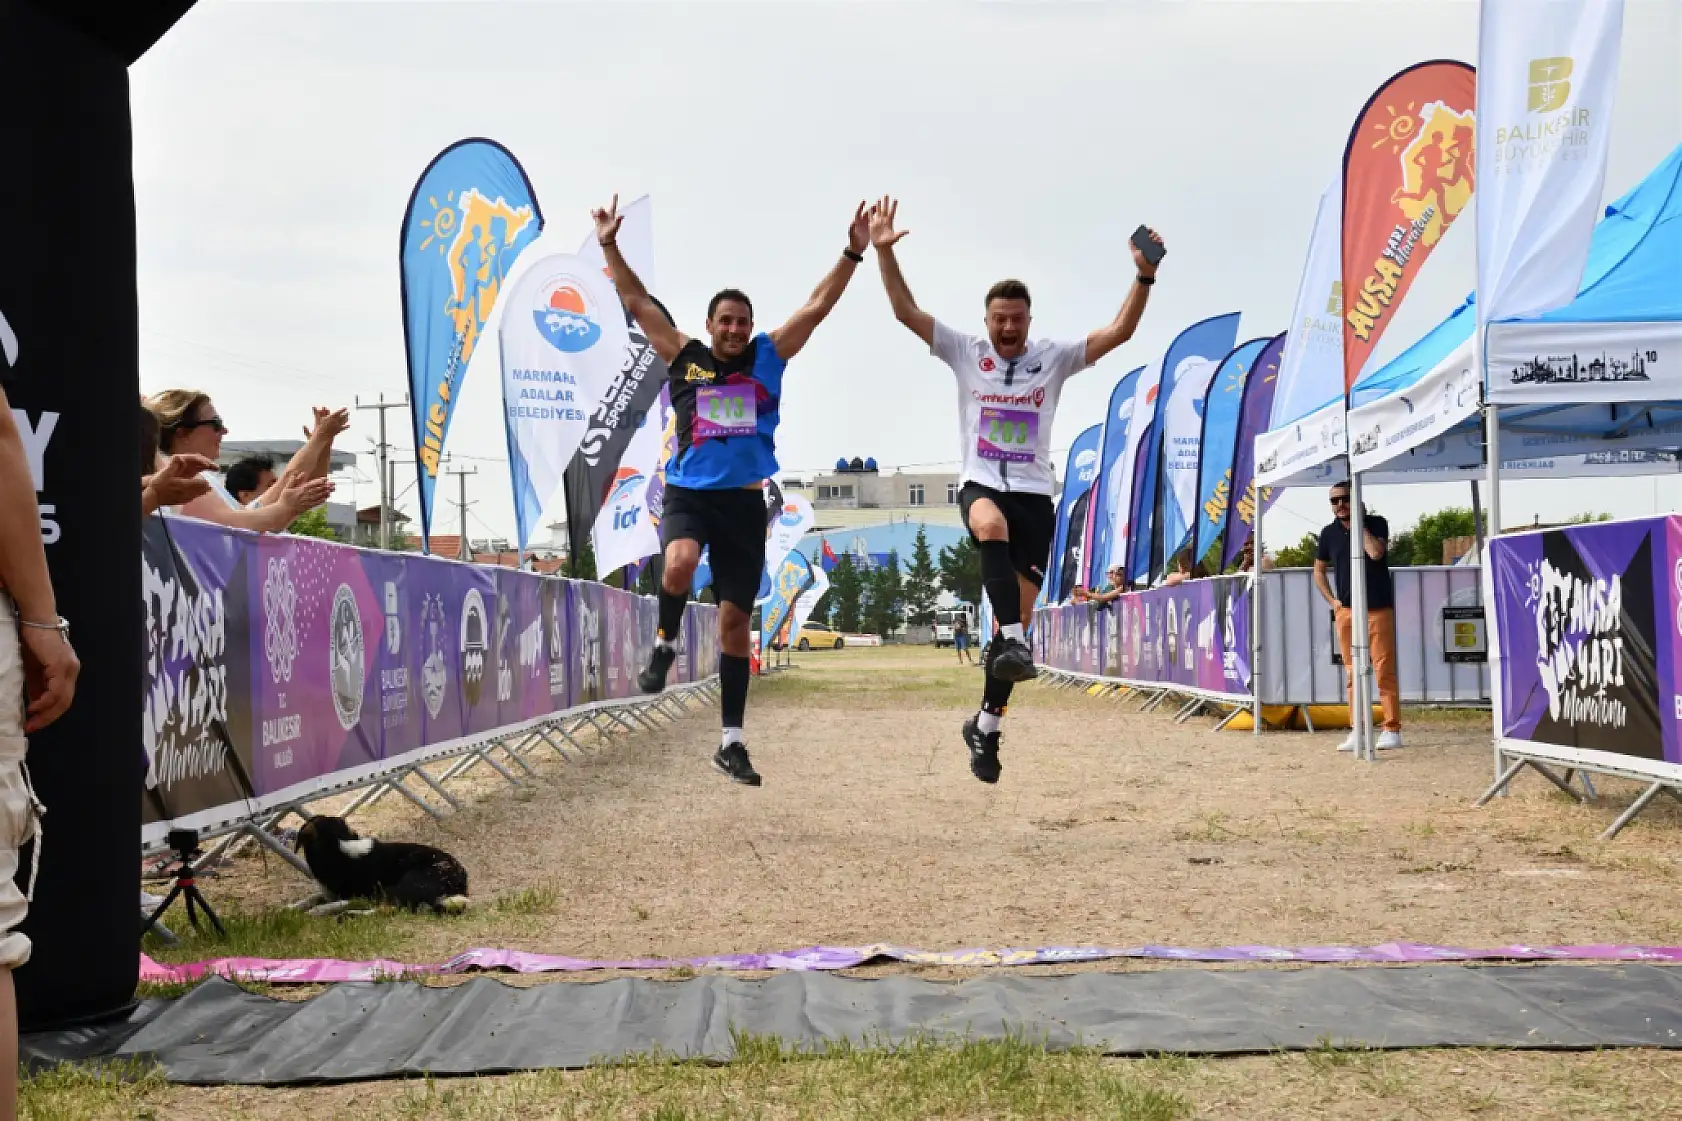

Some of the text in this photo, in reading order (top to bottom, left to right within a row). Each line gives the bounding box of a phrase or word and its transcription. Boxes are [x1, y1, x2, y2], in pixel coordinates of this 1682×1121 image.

[1347, 258, 1403, 343] AUSA
[520, 388, 575, 402] ADALAR
[709, 396, 744, 419] 213
[1577, 637, 1624, 690] YARI
